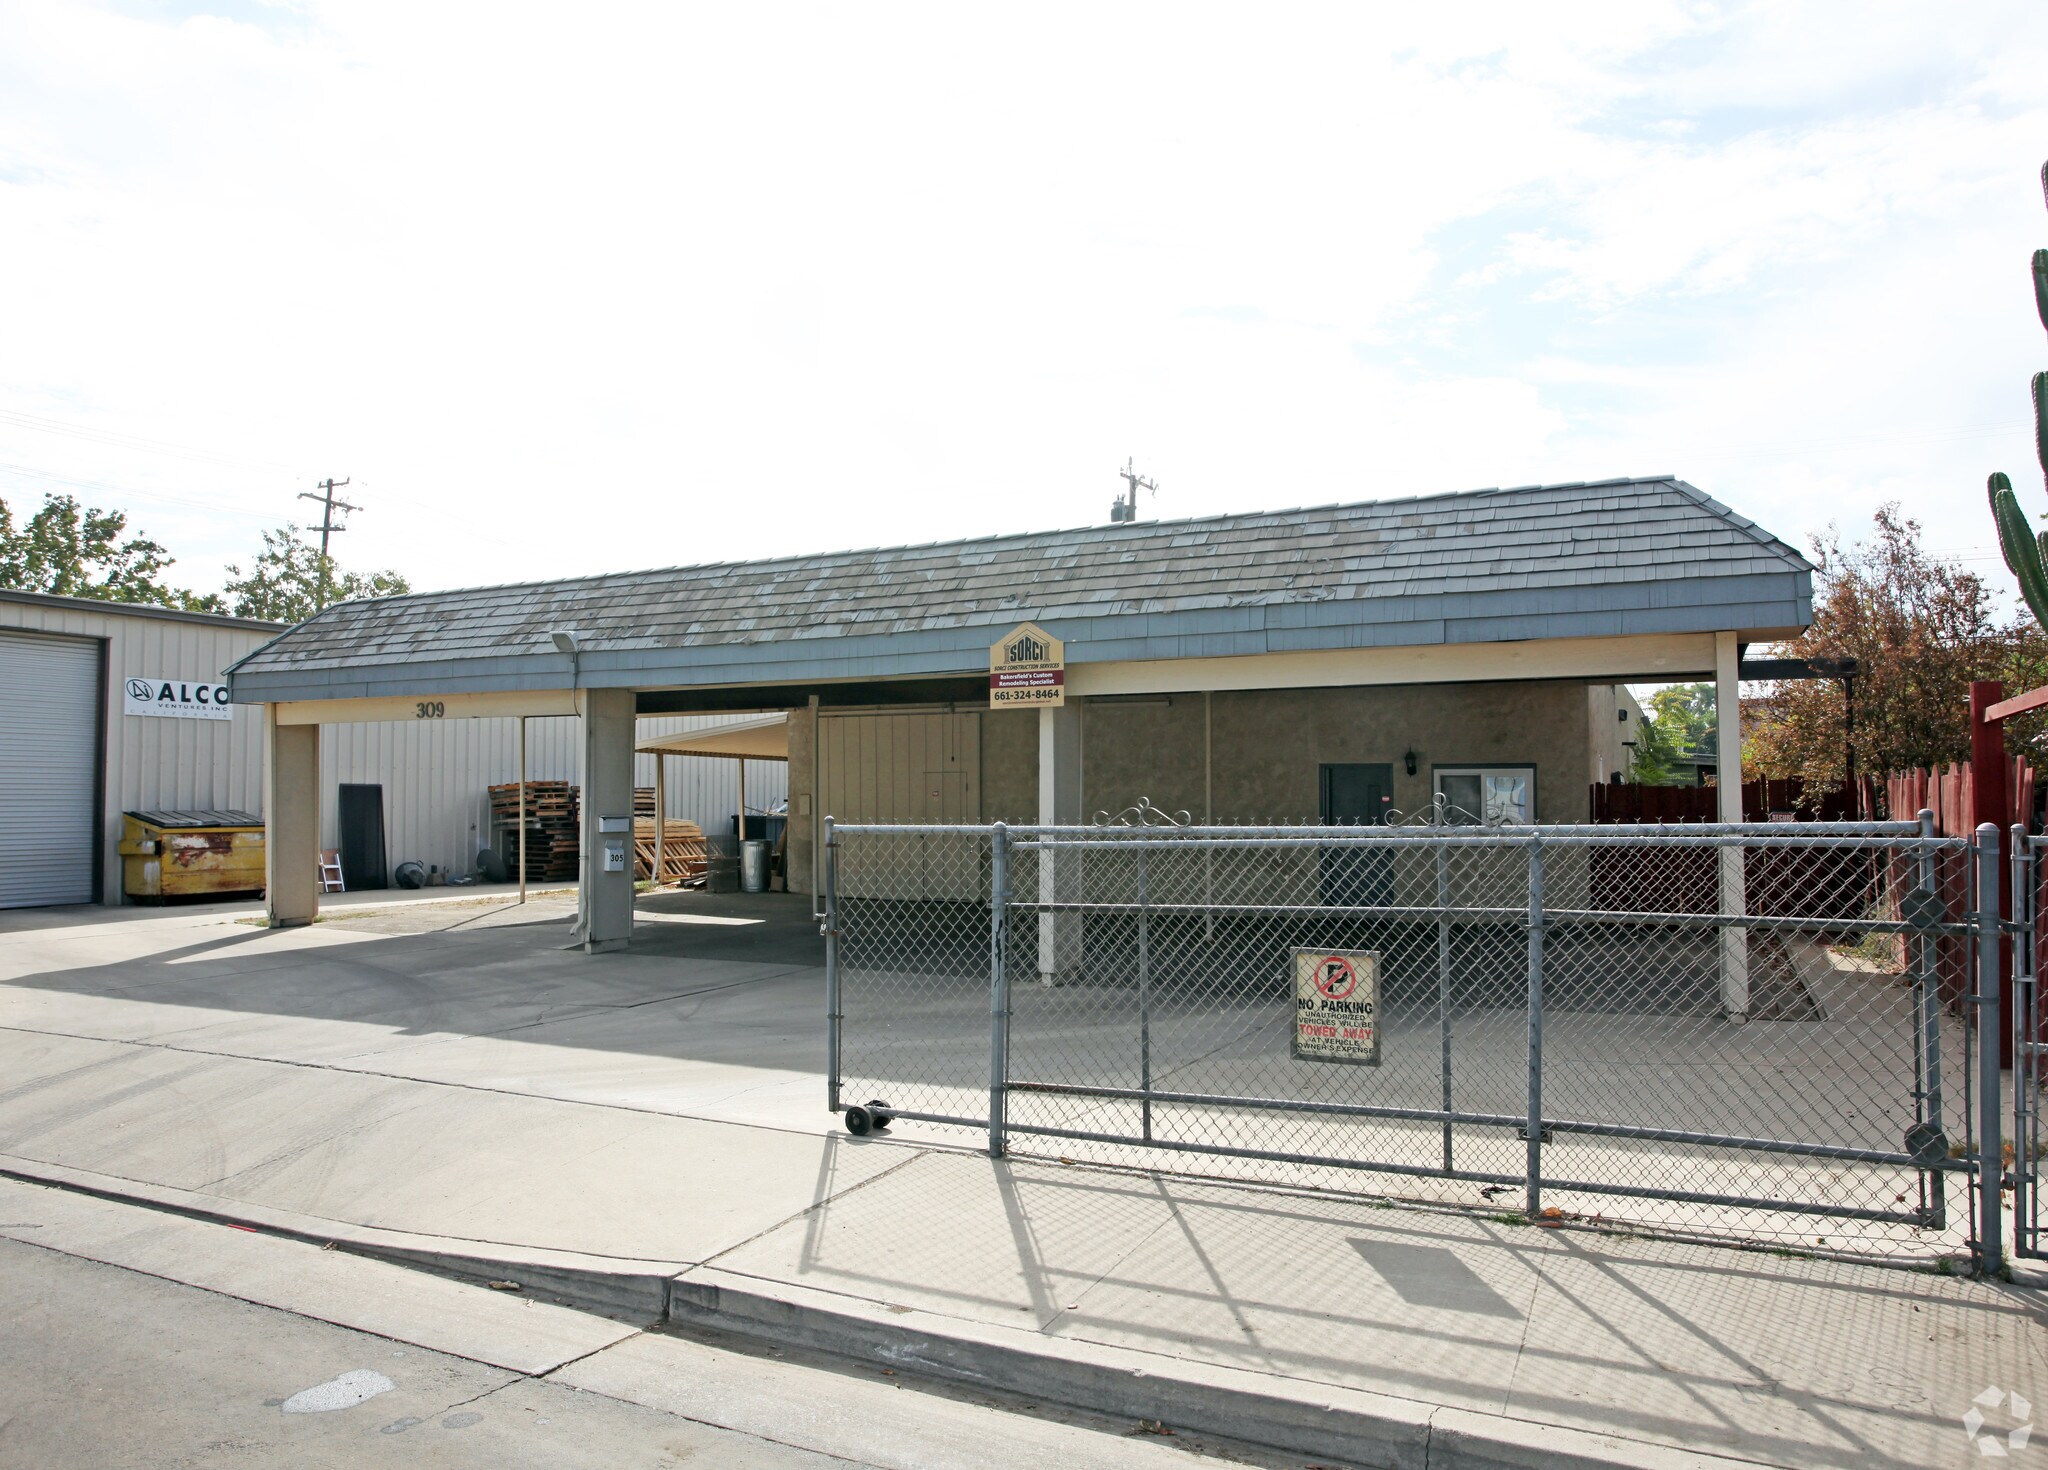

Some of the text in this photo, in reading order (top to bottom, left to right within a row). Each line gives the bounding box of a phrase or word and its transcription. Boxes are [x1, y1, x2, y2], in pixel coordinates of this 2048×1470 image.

[1010, 636, 1043, 662] SORCI
[157, 683, 228, 705] ALCO
[994, 689, 1060, 700] 661-324-8464
[158, 703, 206, 711] VENTURES
[416, 701, 445, 718] 309
[130, 709, 228, 718] CALIFORNIA
[610, 854, 624, 862] 305
[1298, 998, 1373, 1014] NO PARKING
[1305, 1011, 1366, 1021] UNAUTHORIZED
[1298, 1017, 1336, 1026] VEHICLES
[1299, 1024, 1372, 1040] TOWED AWAY
[1325, 1038, 1359, 1046] VEHICLE
